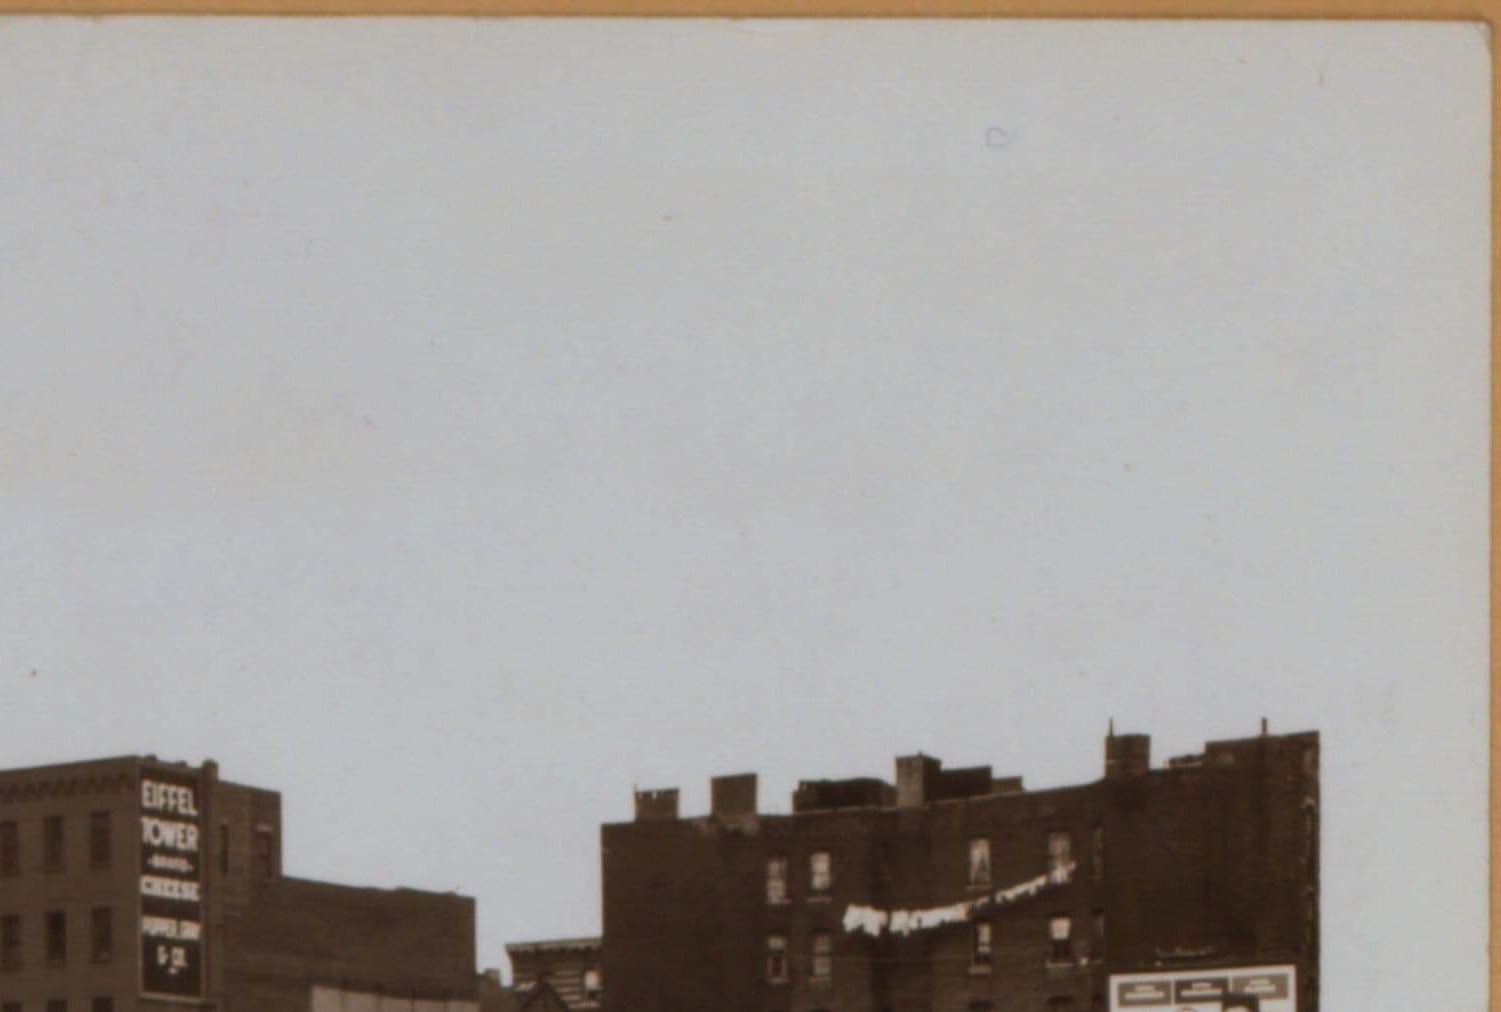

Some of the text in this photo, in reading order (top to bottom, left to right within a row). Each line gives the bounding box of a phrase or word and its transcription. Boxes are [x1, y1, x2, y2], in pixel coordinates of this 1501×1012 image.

[141, 780, 197, 815] EIFFEL
[140, 816, 198, 852] TOWER
[140, 876, 200, 901] CHEESE
